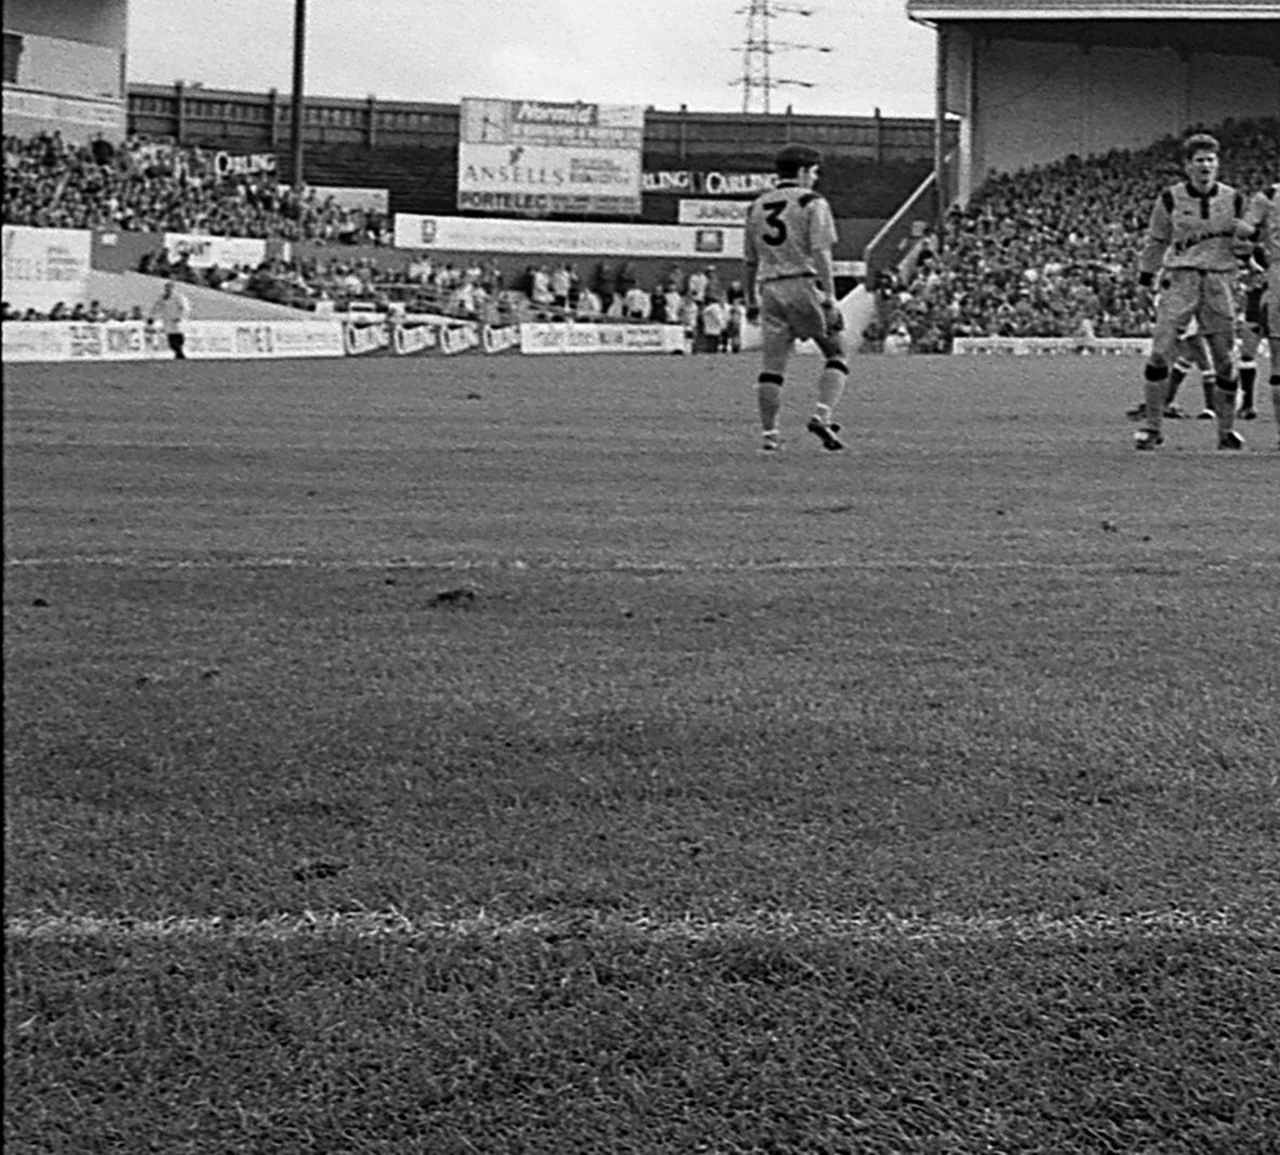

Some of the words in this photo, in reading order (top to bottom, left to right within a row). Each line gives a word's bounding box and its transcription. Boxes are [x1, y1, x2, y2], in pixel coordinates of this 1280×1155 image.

[463, 164, 564, 186] ANSELLS
[705, 171, 780, 194] CARLING
[761, 199, 789, 247] 3
